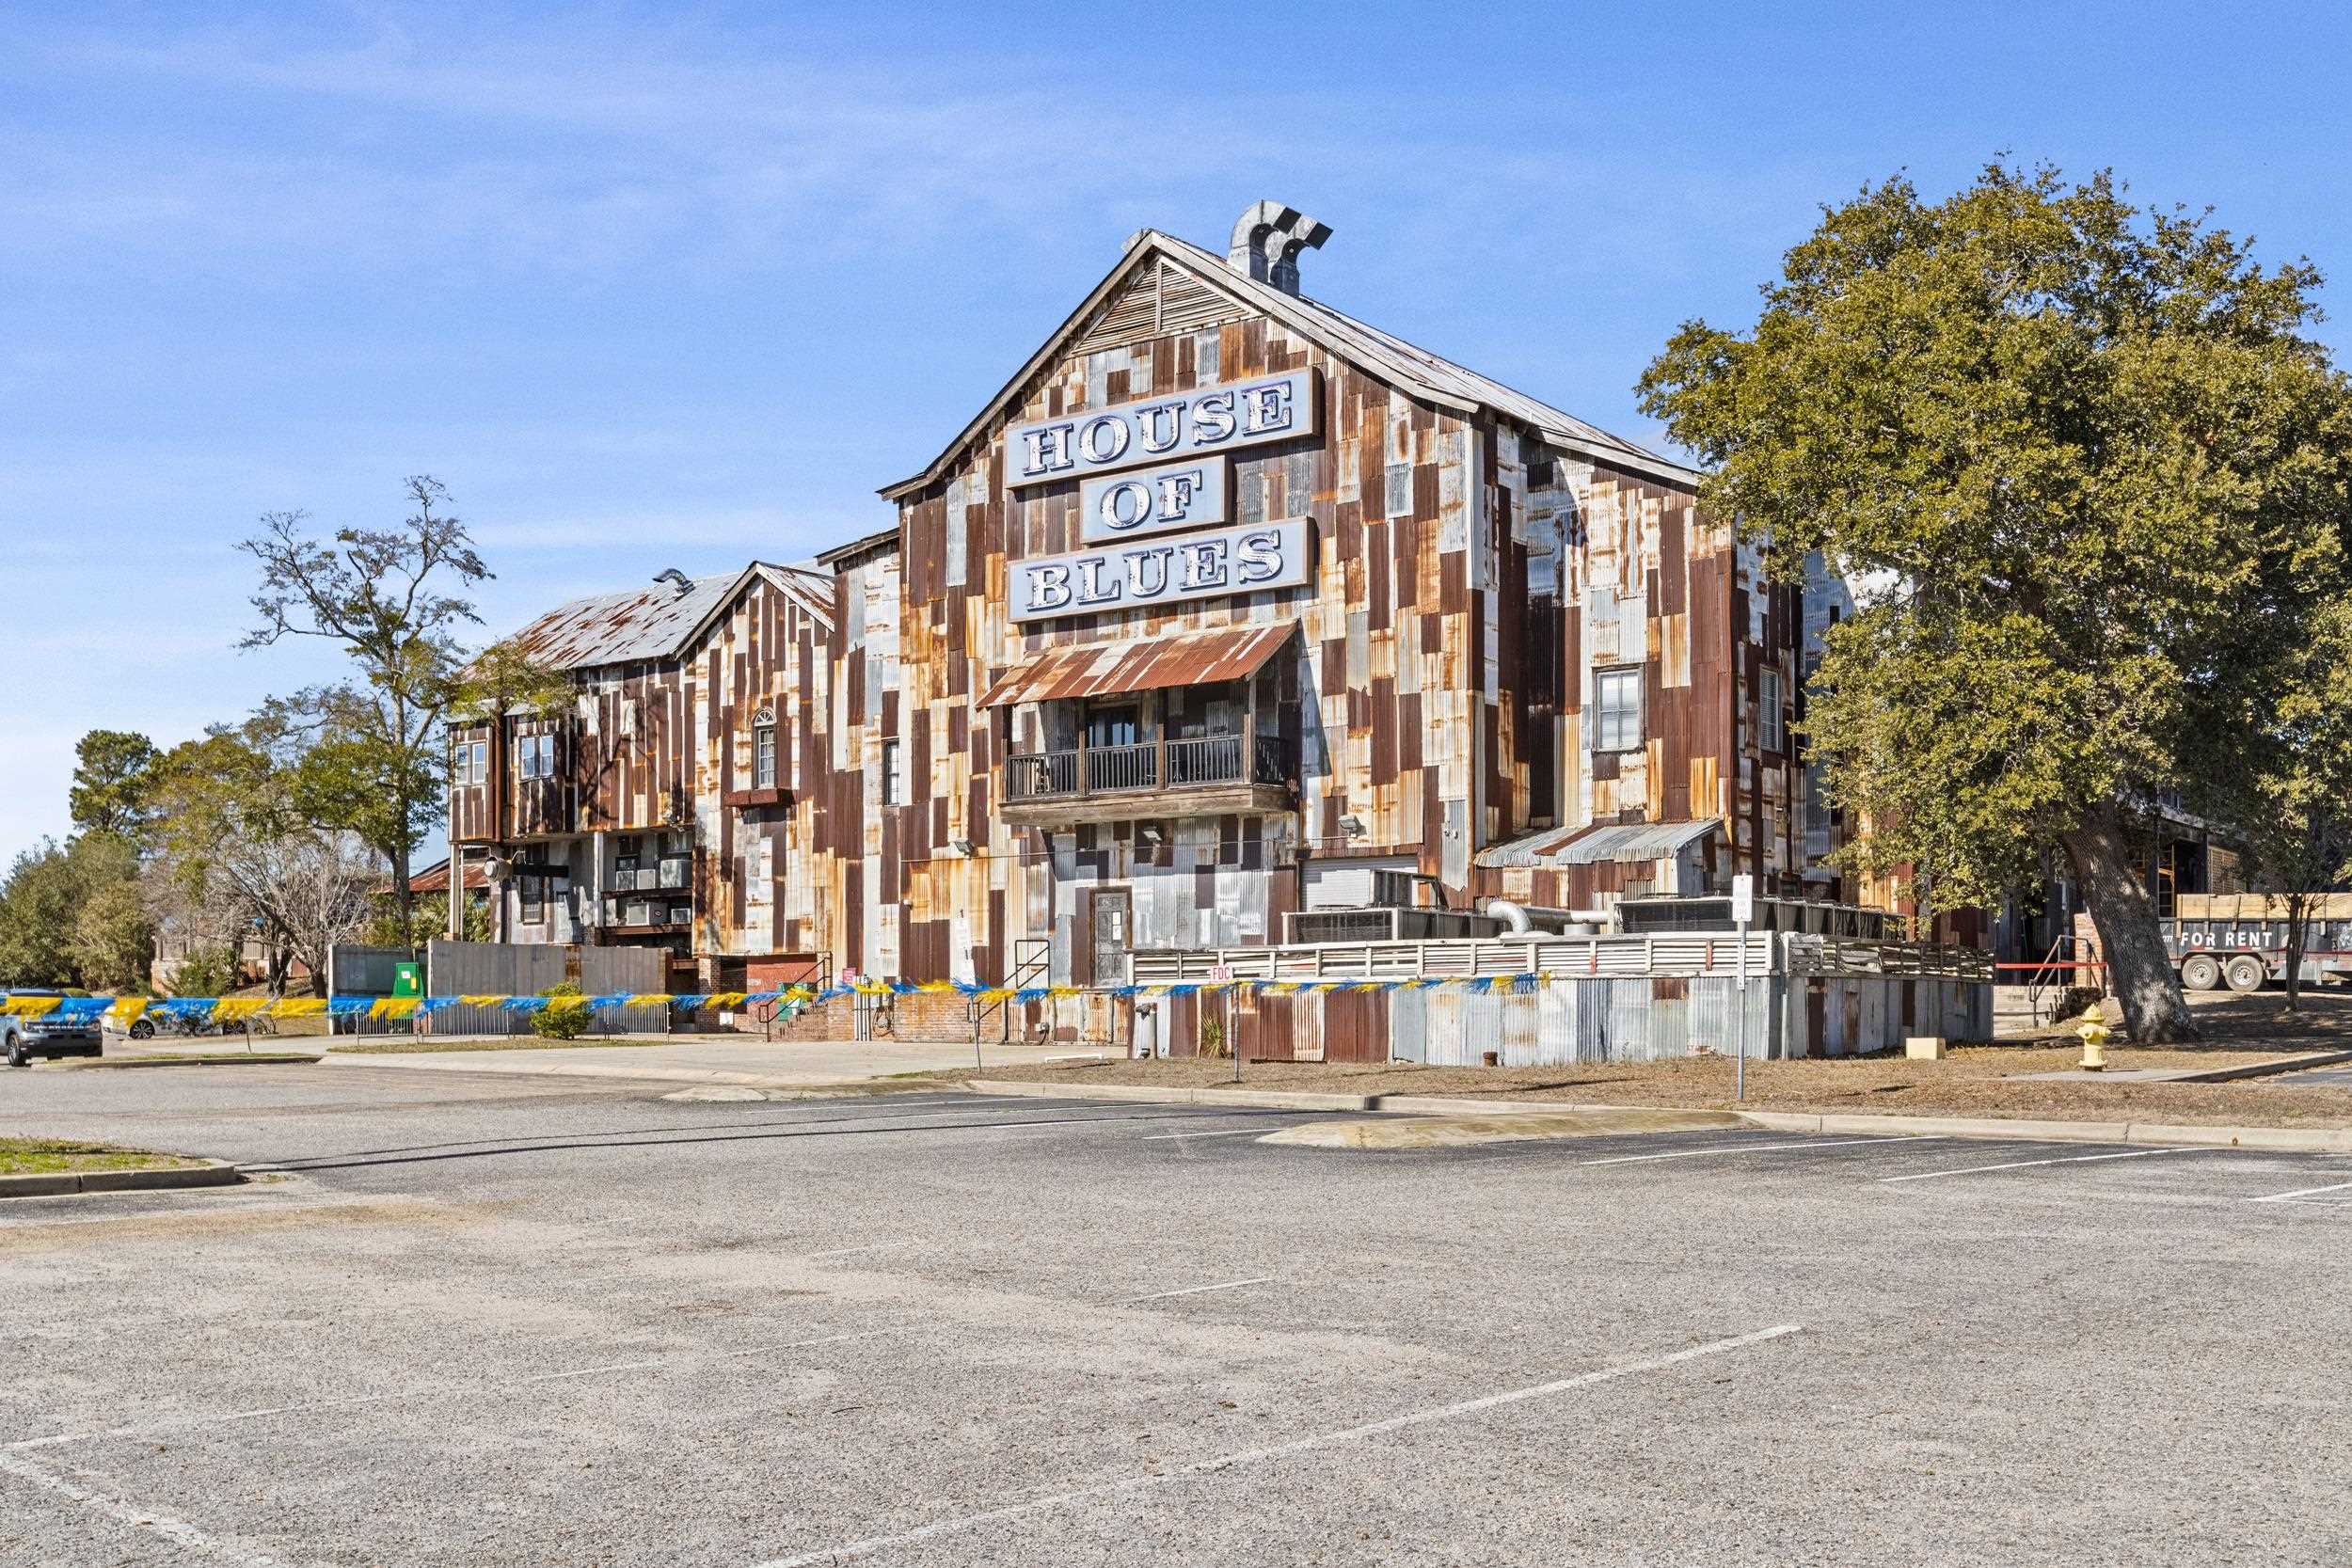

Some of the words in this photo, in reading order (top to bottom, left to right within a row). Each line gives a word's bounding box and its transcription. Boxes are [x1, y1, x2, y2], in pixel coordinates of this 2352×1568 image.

[1024, 381, 1291, 475] HOUSE
[1101, 470, 1202, 530] OF
[1026, 530, 1281, 611] BLUES
[2181, 931, 2216, 946] FOR
[2225, 931, 2272, 946] RENT
[1213, 967, 1231, 980] FDC
